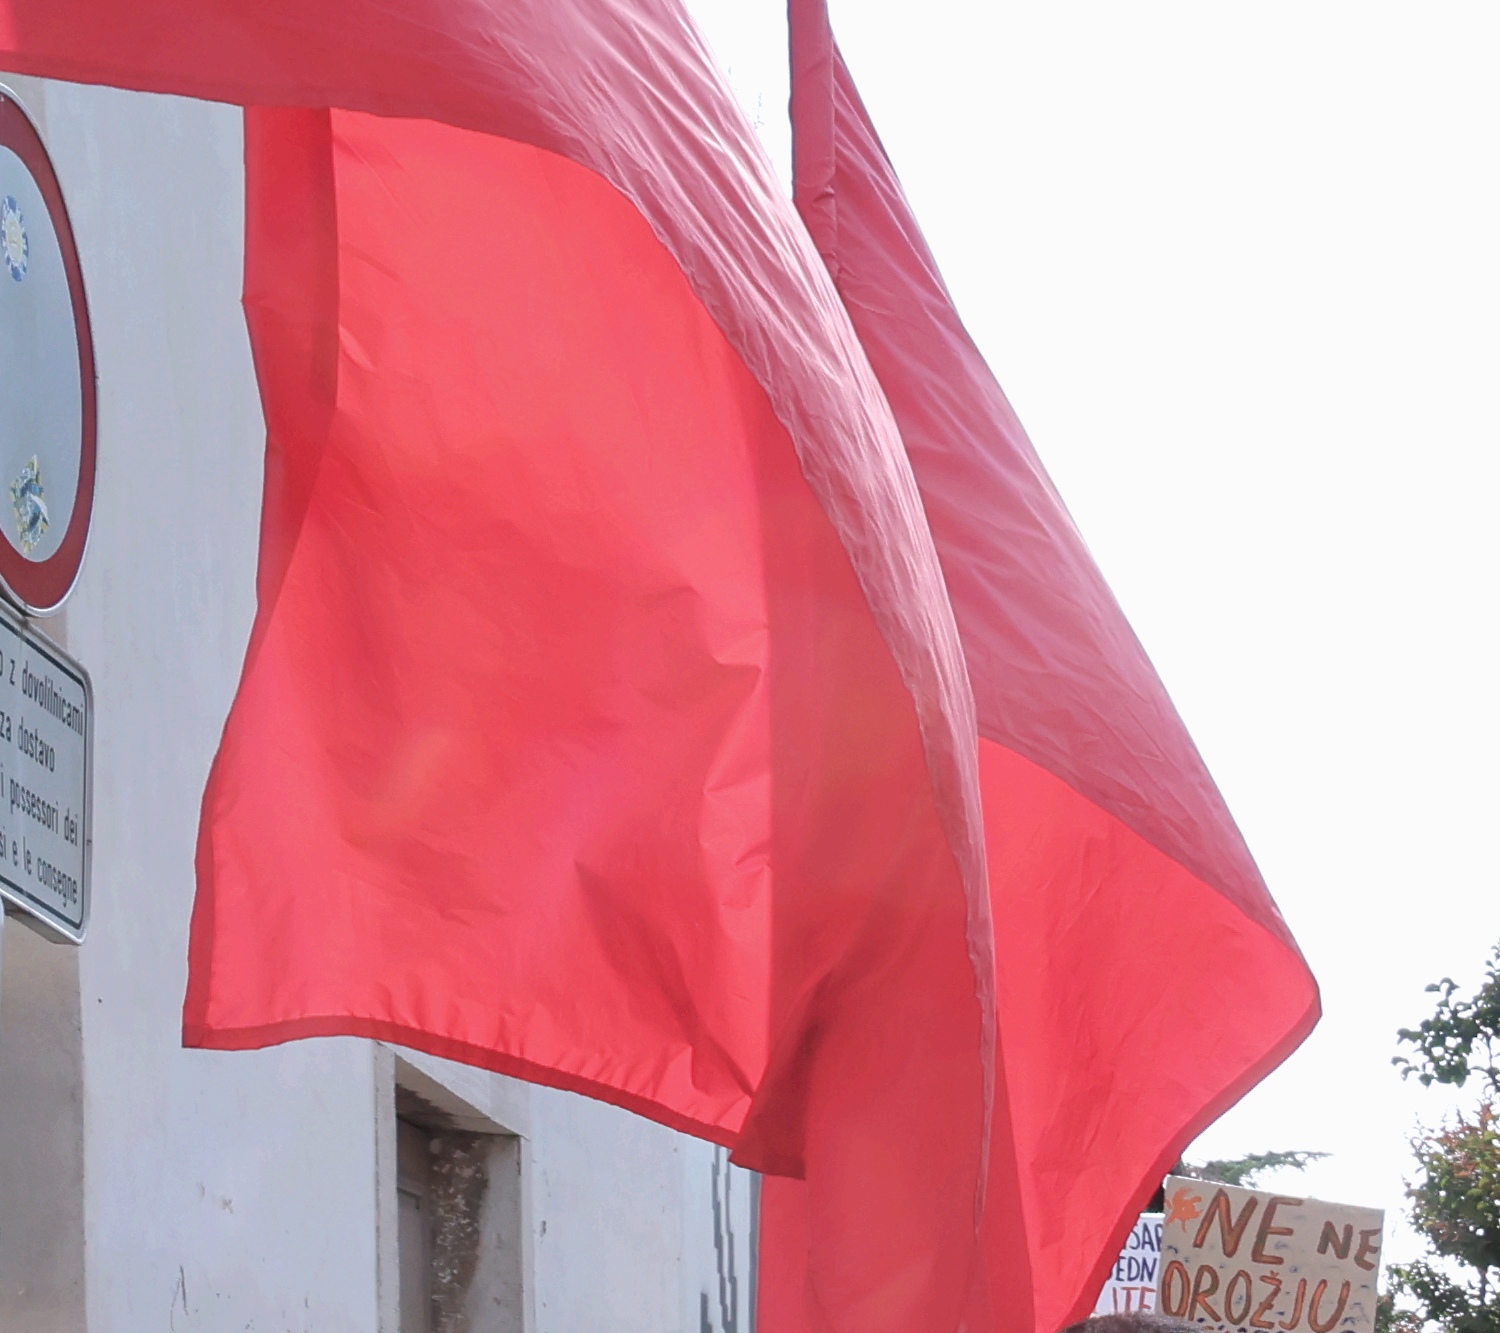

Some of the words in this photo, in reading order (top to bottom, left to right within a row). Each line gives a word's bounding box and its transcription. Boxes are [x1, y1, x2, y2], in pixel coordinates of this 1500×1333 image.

[18, 716, 55, 773] dostavo
[10, 778, 59, 835] possessori
[64, 808, 79, 847] dei
[23, 835, 32, 876] le
[37, 857, 78, 908] consegne
[1193, 1188, 1304, 1266] NE
[1317, 1220, 1383, 1272] NE
[1161, 1260, 1351, 1333] OROŽJU
